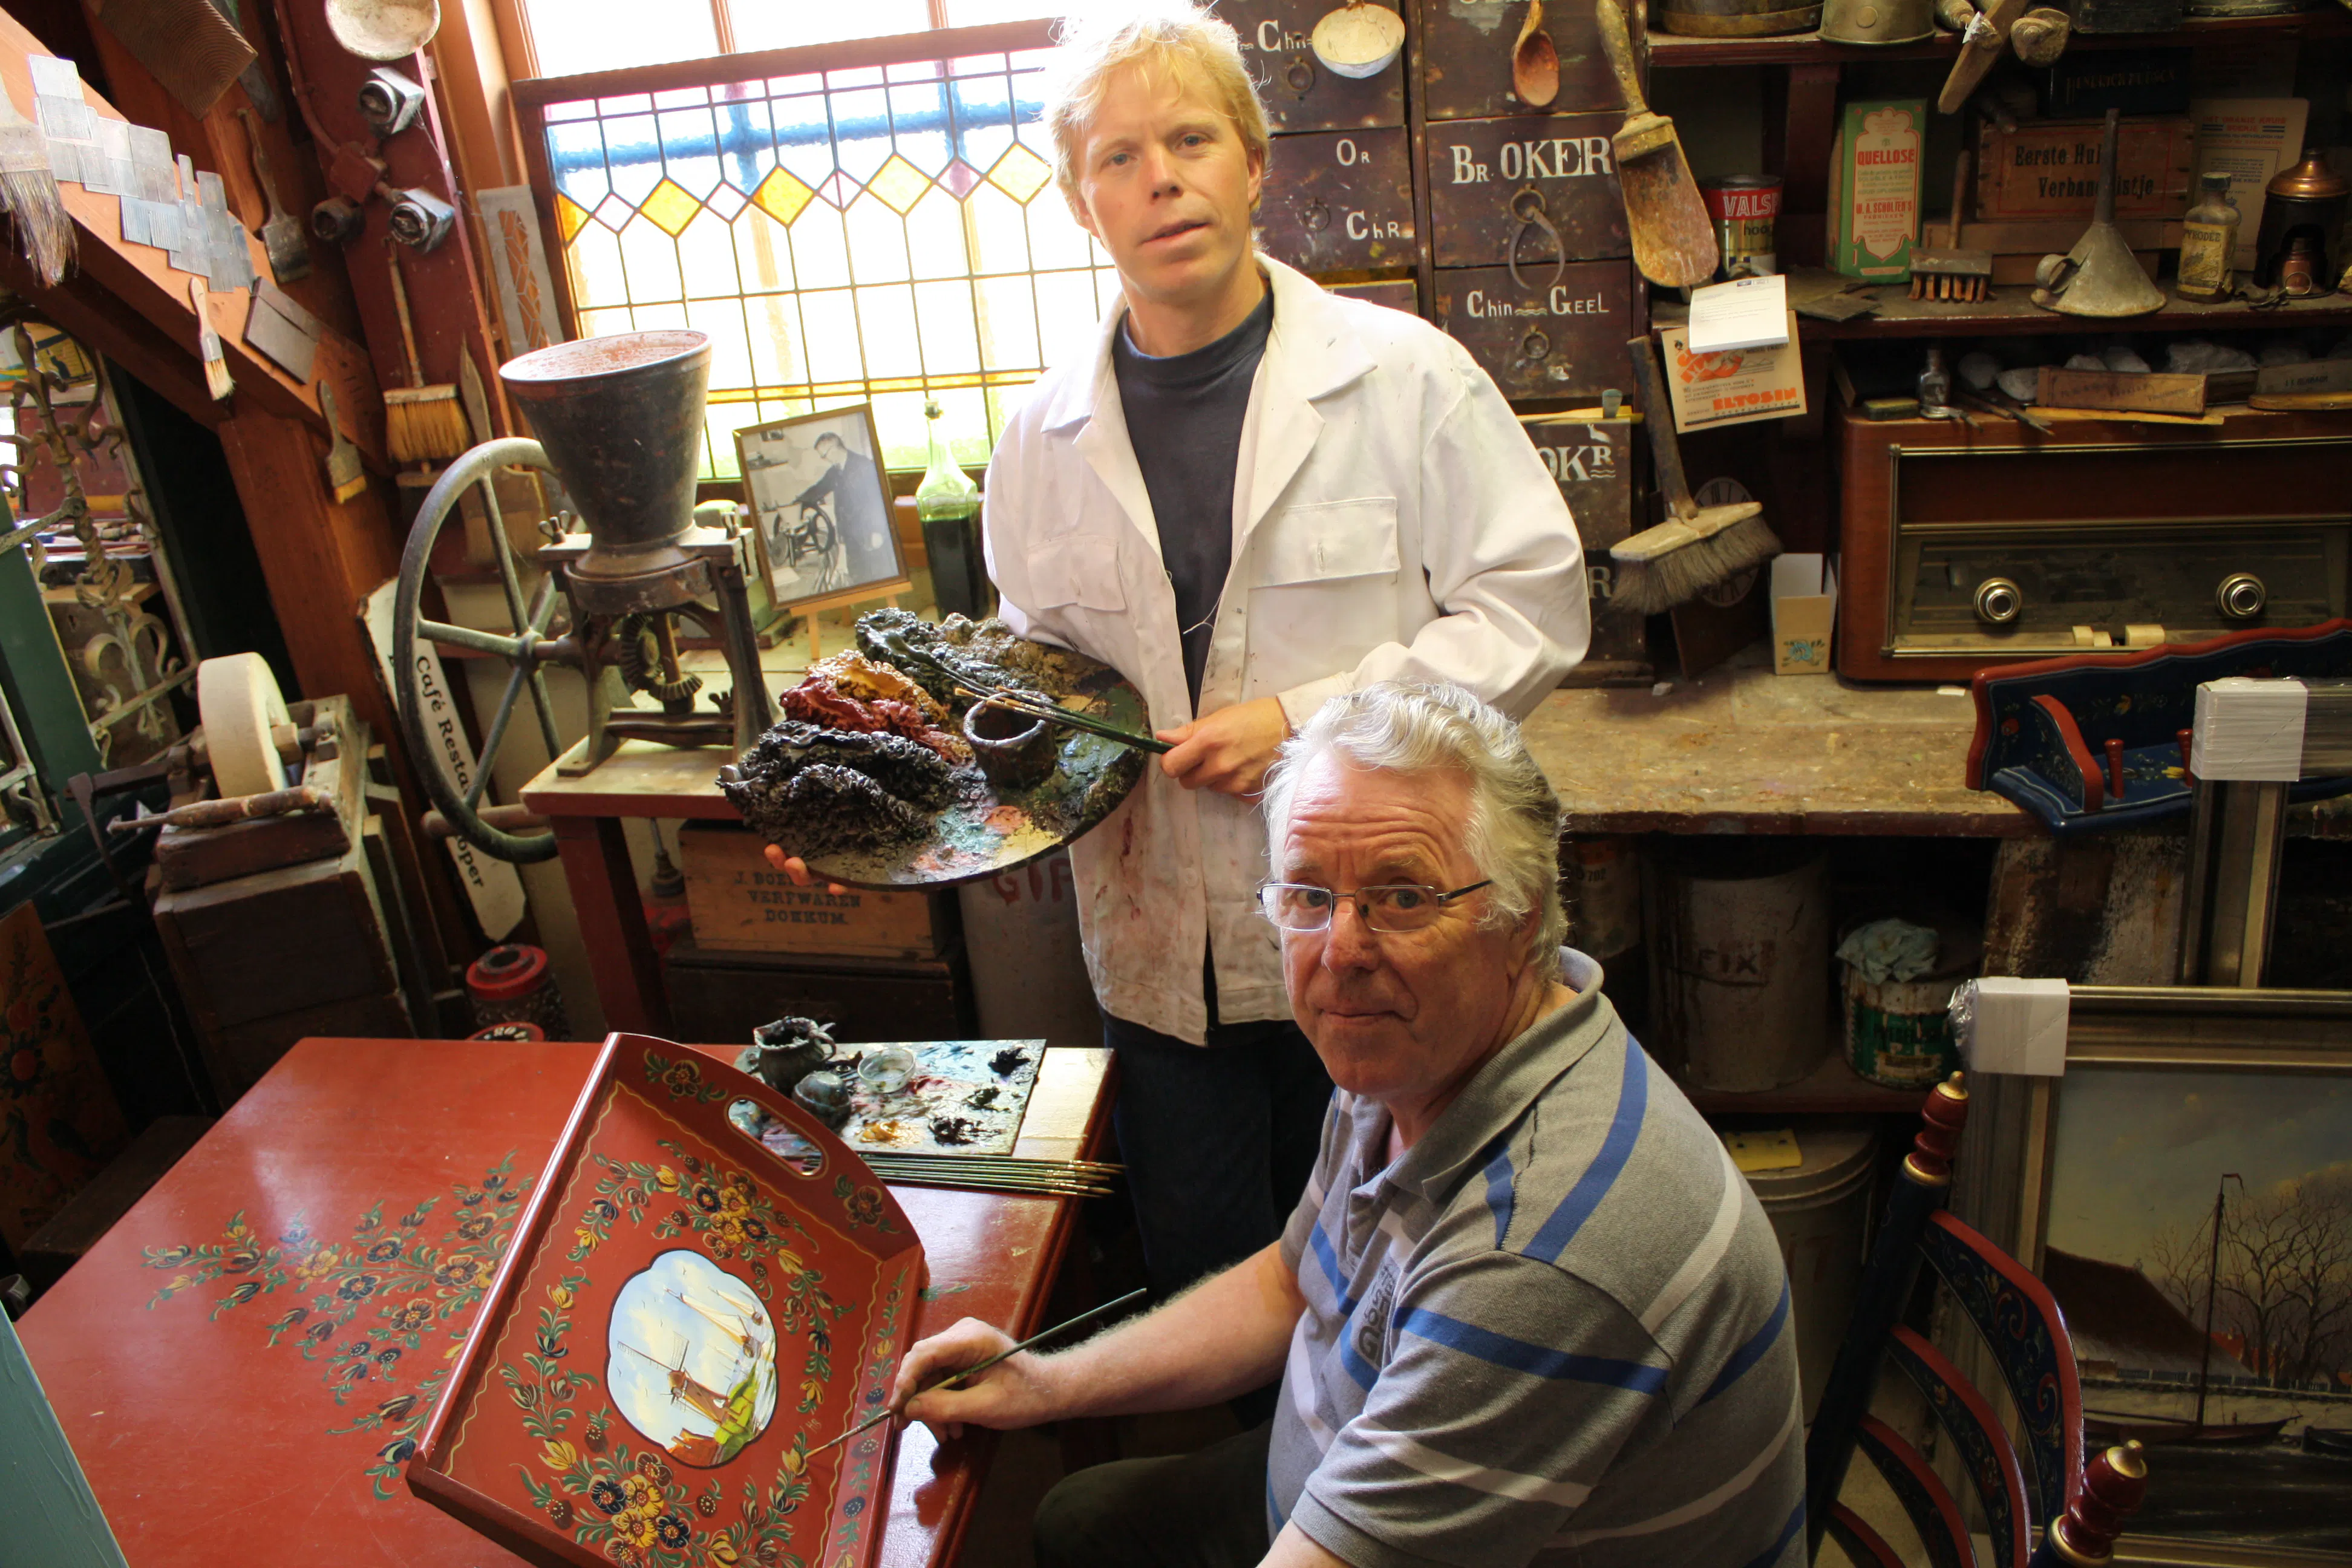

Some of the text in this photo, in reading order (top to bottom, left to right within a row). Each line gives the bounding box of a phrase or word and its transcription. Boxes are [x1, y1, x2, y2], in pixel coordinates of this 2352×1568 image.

[1500, 136, 1614, 180] OKER
[1857, 149, 1915, 166] QUELLOSE
[2015, 142, 2103, 166] Eerste Hul
[2038, 174, 2155, 200] Verbanistje
[416, 655, 446, 713] Café
[457, 838, 485, 887] oper
[747, 890, 861, 907] VERFWAREN
